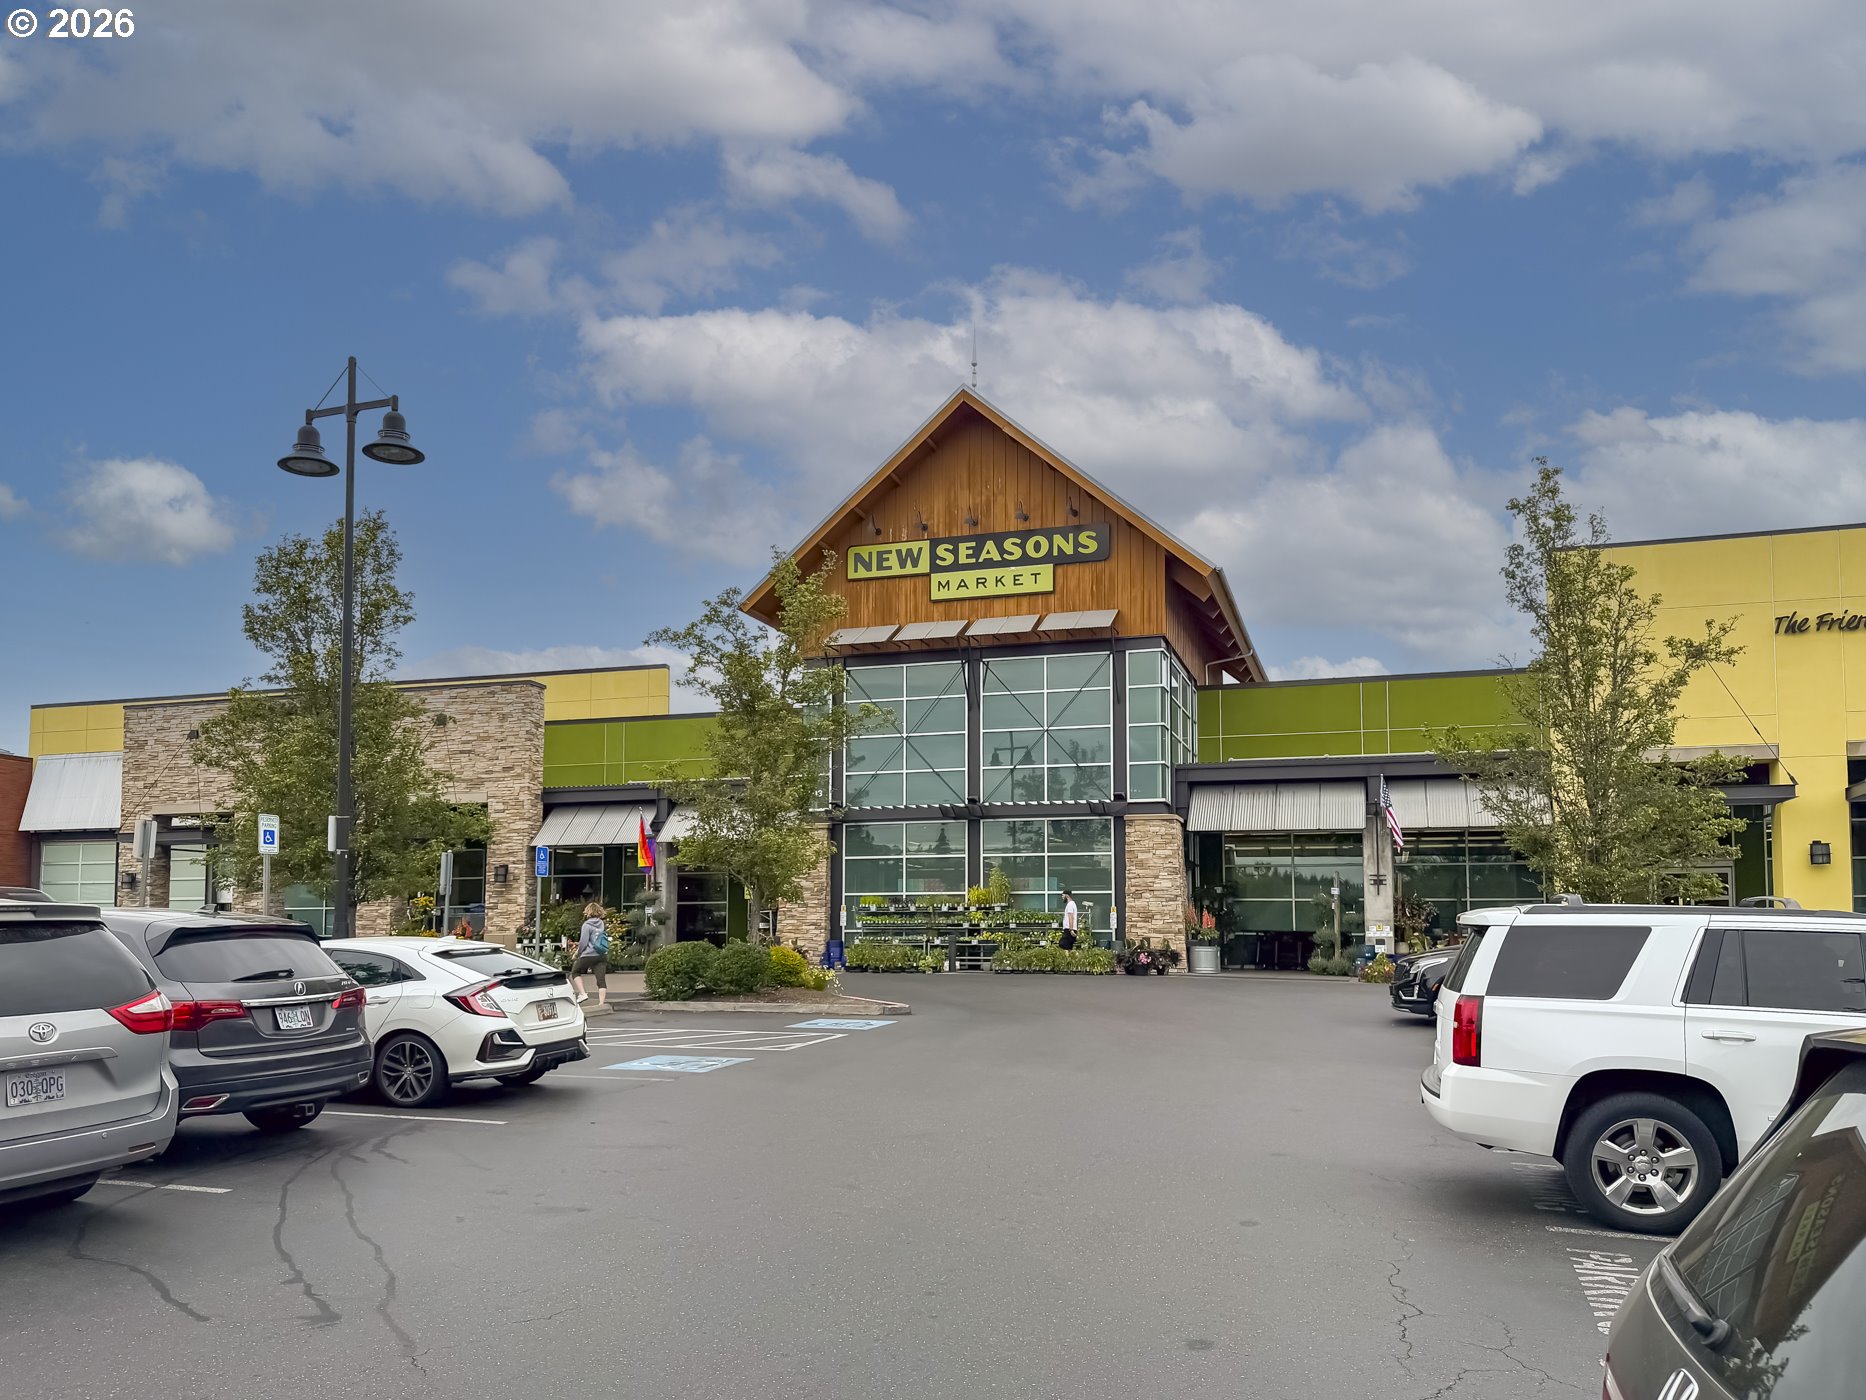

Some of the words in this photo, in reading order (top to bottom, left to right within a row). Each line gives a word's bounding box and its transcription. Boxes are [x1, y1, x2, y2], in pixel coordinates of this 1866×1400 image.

[853, 546, 924, 574] NEW
[935, 530, 1099, 567] SEASONS
[937, 572, 1042, 592] MARKET
[1775, 610, 1811, 634] The
[10, 1079, 33, 1099] 030
[41, 1075, 64, 1094] QPG
